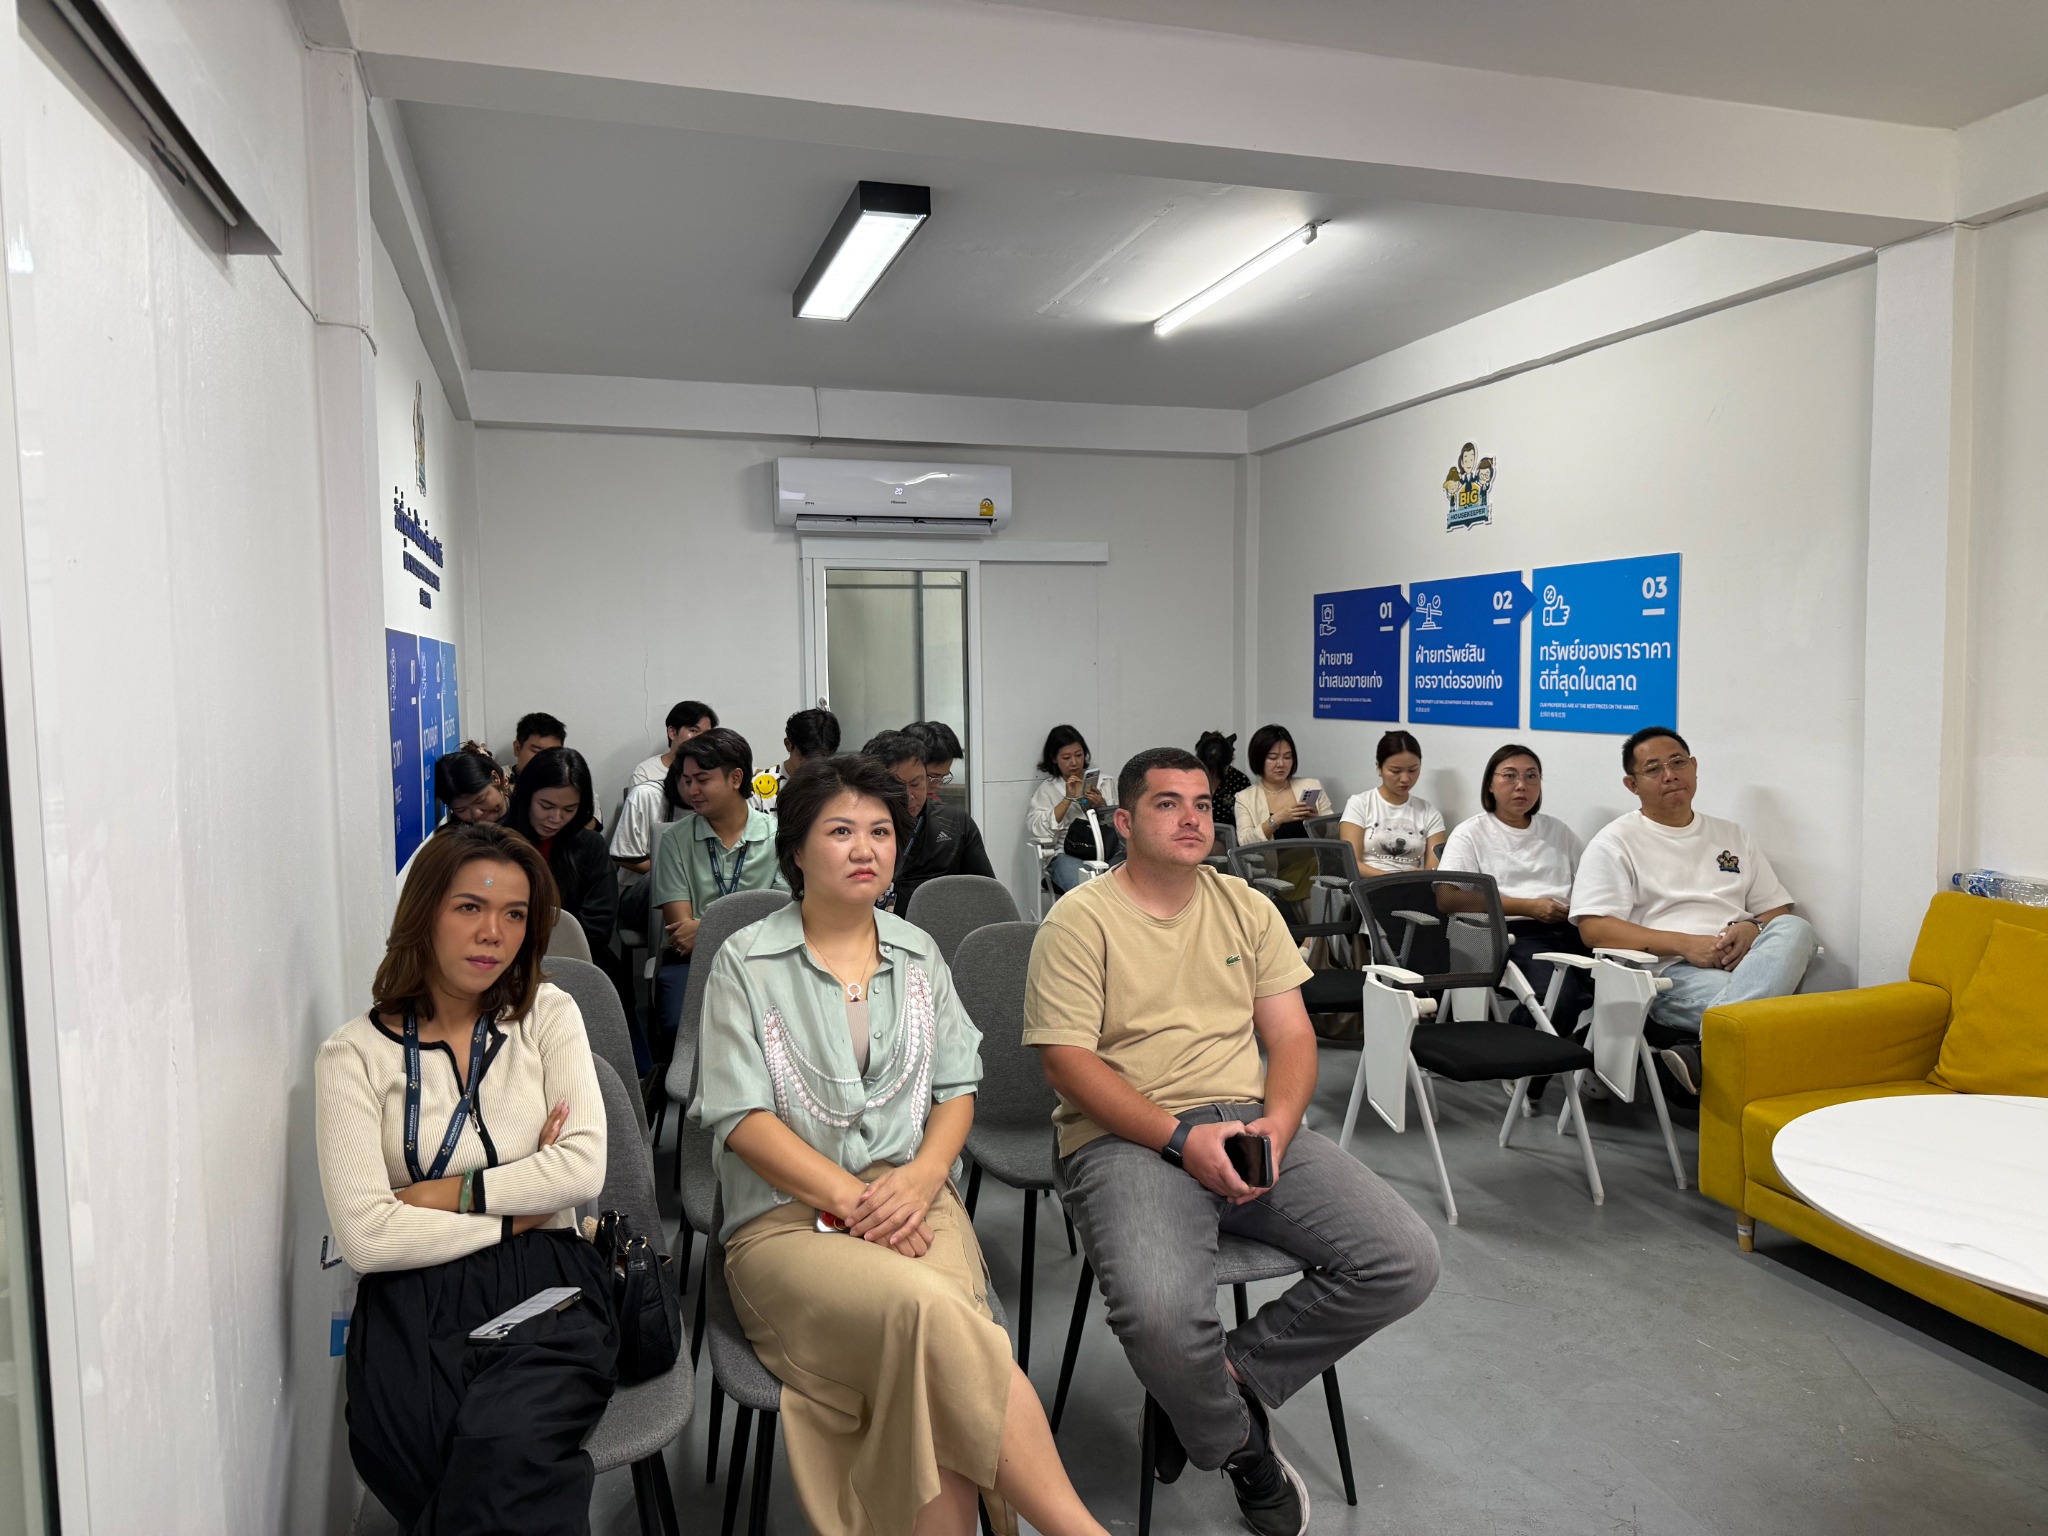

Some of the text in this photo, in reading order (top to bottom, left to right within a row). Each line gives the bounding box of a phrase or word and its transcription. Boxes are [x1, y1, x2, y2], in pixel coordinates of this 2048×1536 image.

[1459, 489, 1479, 506] BIG
[1450, 508, 1486, 521] HOUSEKEEPER
[1642, 576, 1668, 599] 03
[1379, 602, 1392, 619] 01
[1492, 591, 1513, 611] 02
[1319, 648, 1353, 666] ฝ่ายขาย
[1415, 643, 1486, 663] ฝ่ายทรัพย์สิน
[1539, 638, 1671, 661] ทรัพย์ของเราราคา
[1318, 670, 1383, 688] นำเสนอขายเก่ง
[1415, 669, 1503, 690] เจรจาต่อรองเก่ง
[1539, 663, 1637, 697] ดีที่สุดในตลาด
